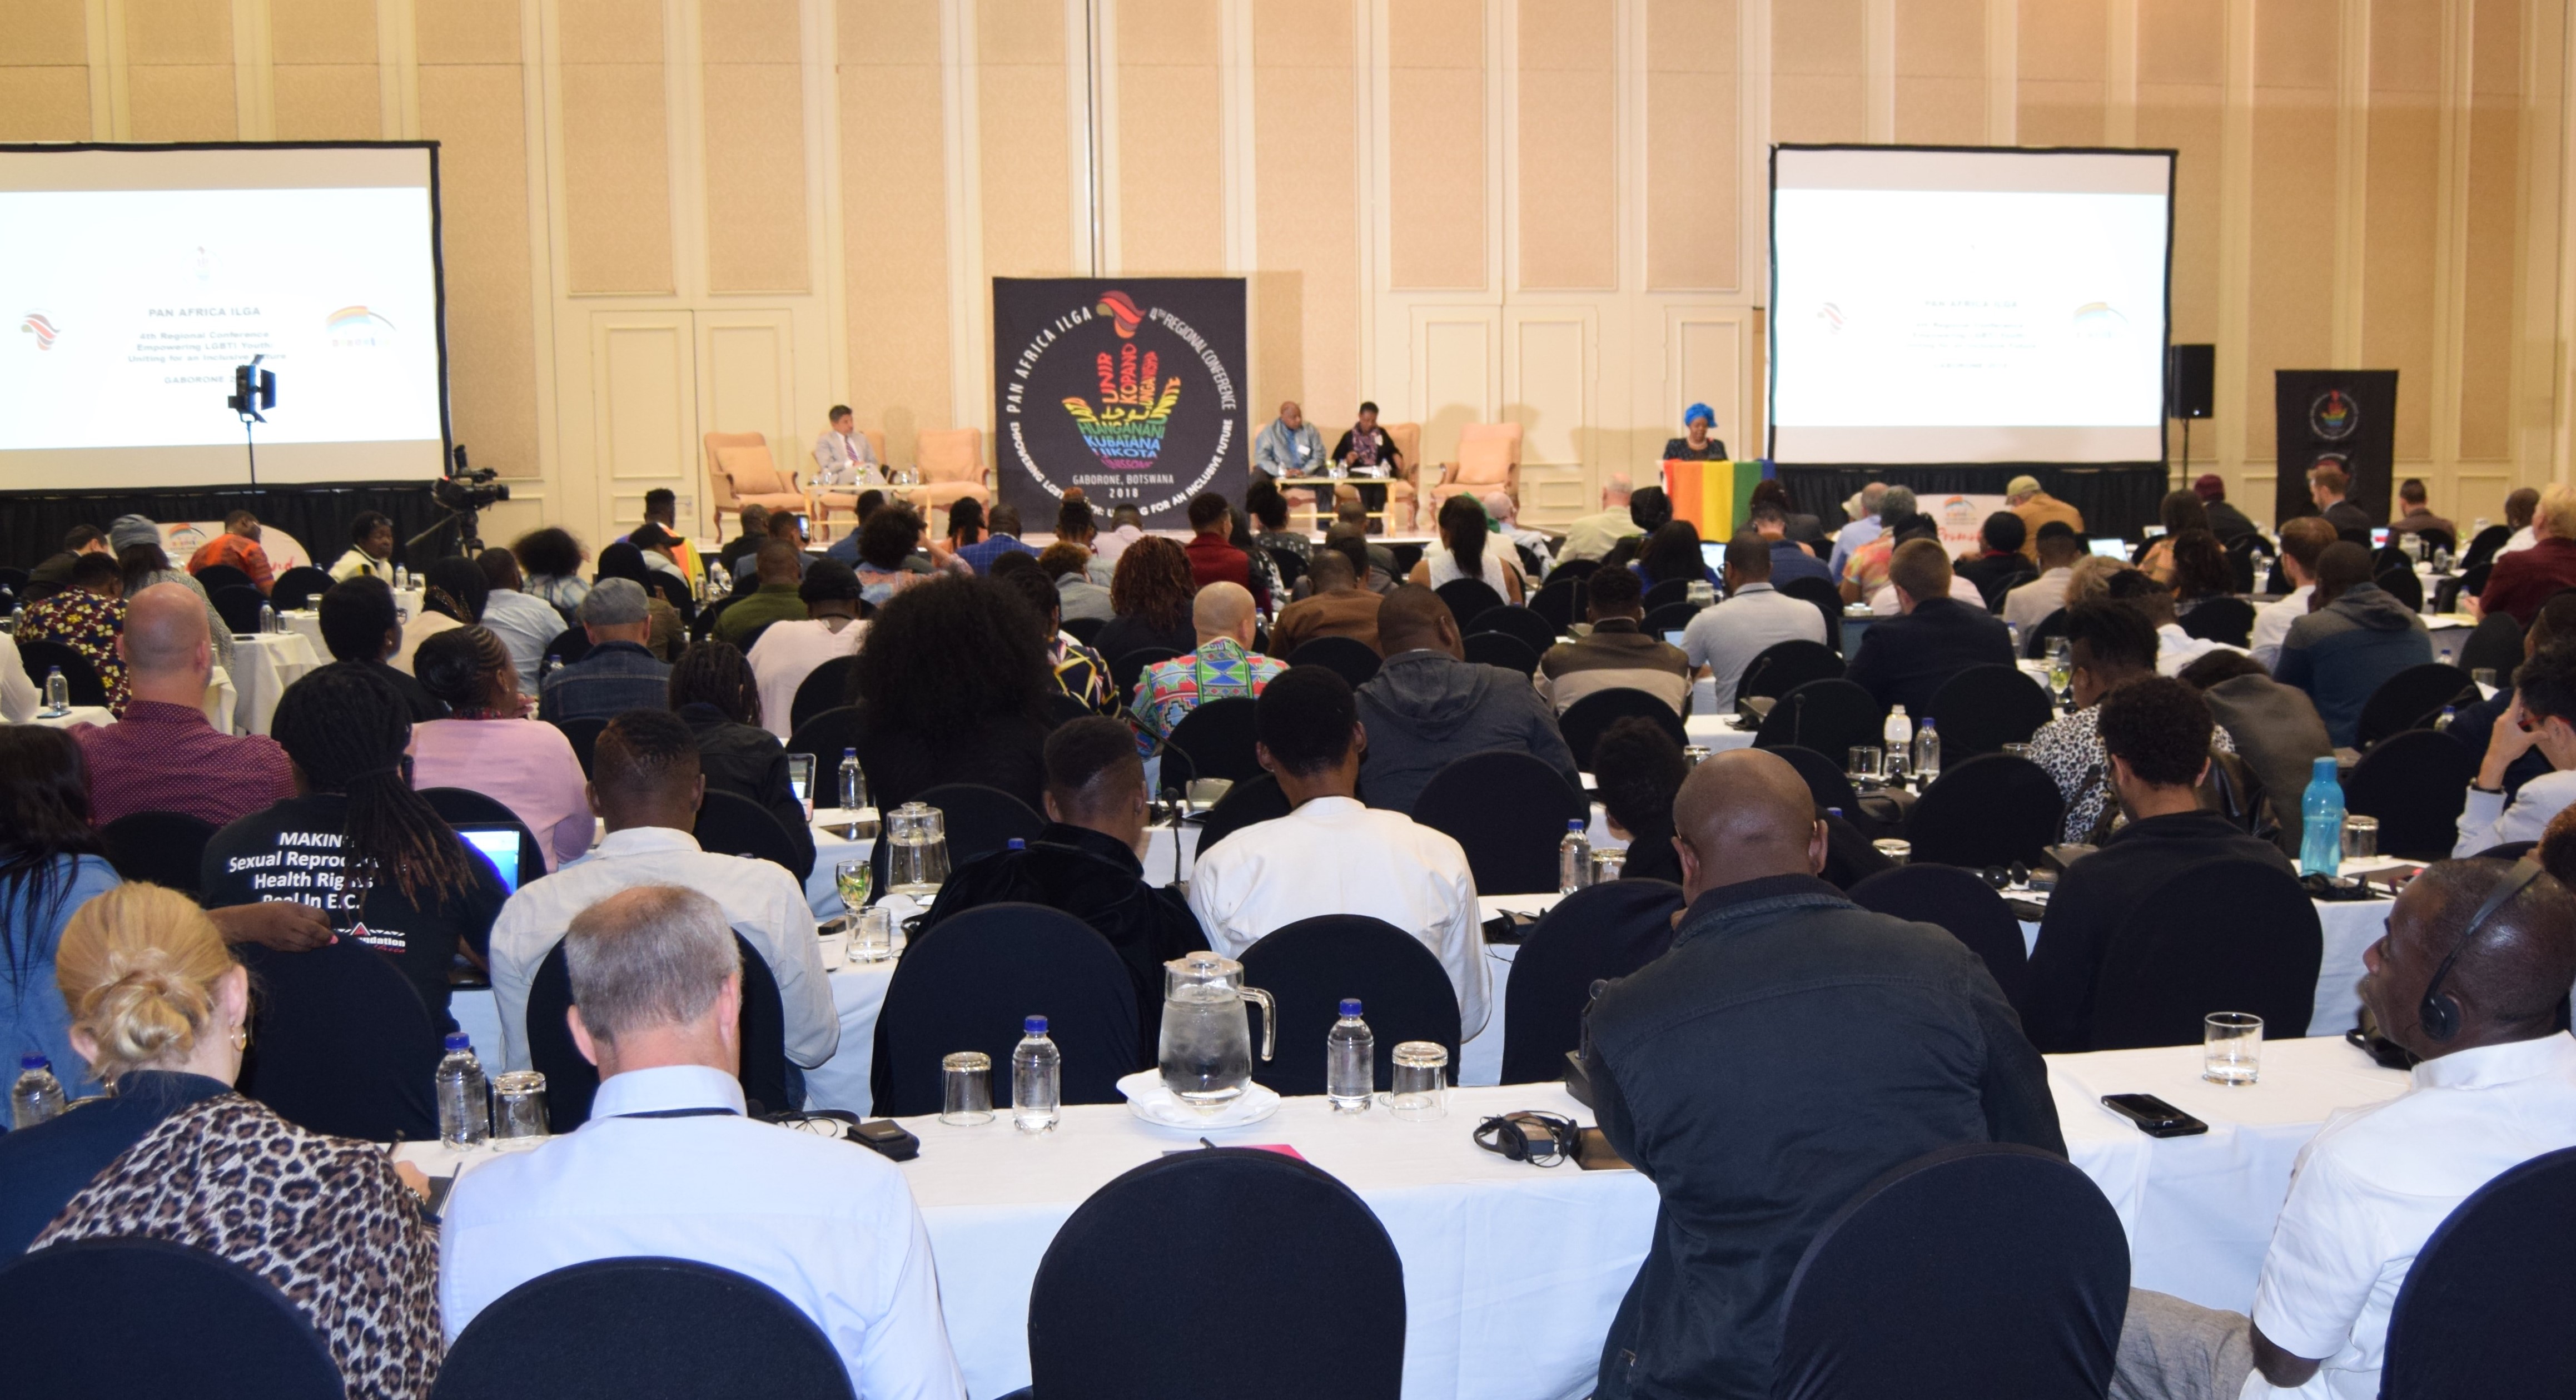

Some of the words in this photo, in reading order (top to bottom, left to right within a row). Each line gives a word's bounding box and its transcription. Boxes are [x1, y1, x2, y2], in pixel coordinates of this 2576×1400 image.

[148, 309, 174, 317] PAN
[178, 307, 226, 316] AFRICA
[231, 307, 261, 315] ILGA
[1006, 383, 1024, 413] PAN
[1015, 329, 1056, 379] AFRICA
[1055, 306, 1092, 332] ILGA
[1163, 313, 1208, 354] REGIONAL
[1201, 349, 1236, 410] CONFERENCE
[1120, 342, 1137, 404] KOPANO
[1009, 421, 1046, 483] EMPOWERING
[1150, 500, 1171, 514] FOR
[1172, 492, 1188, 506] AN
[1185, 455, 1222, 497] INCLUSIVE
[1216, 419, 1233, 455] FUTURE
[1072, 474, 1123, 486] GABORONE,
[1126, 474, 1174, 485] BOTSWANA
[1109, 488, 1138, 499] 2018
[280, 832, 355, 848] MAKIN
[229, 851, 281, 873] Sexual
[255, 871, 311, 890] Health
[317, 872, 374, 891] Rigs
[305, 893, 321, 908] In
[327, 893, 360, 910] E.C.
